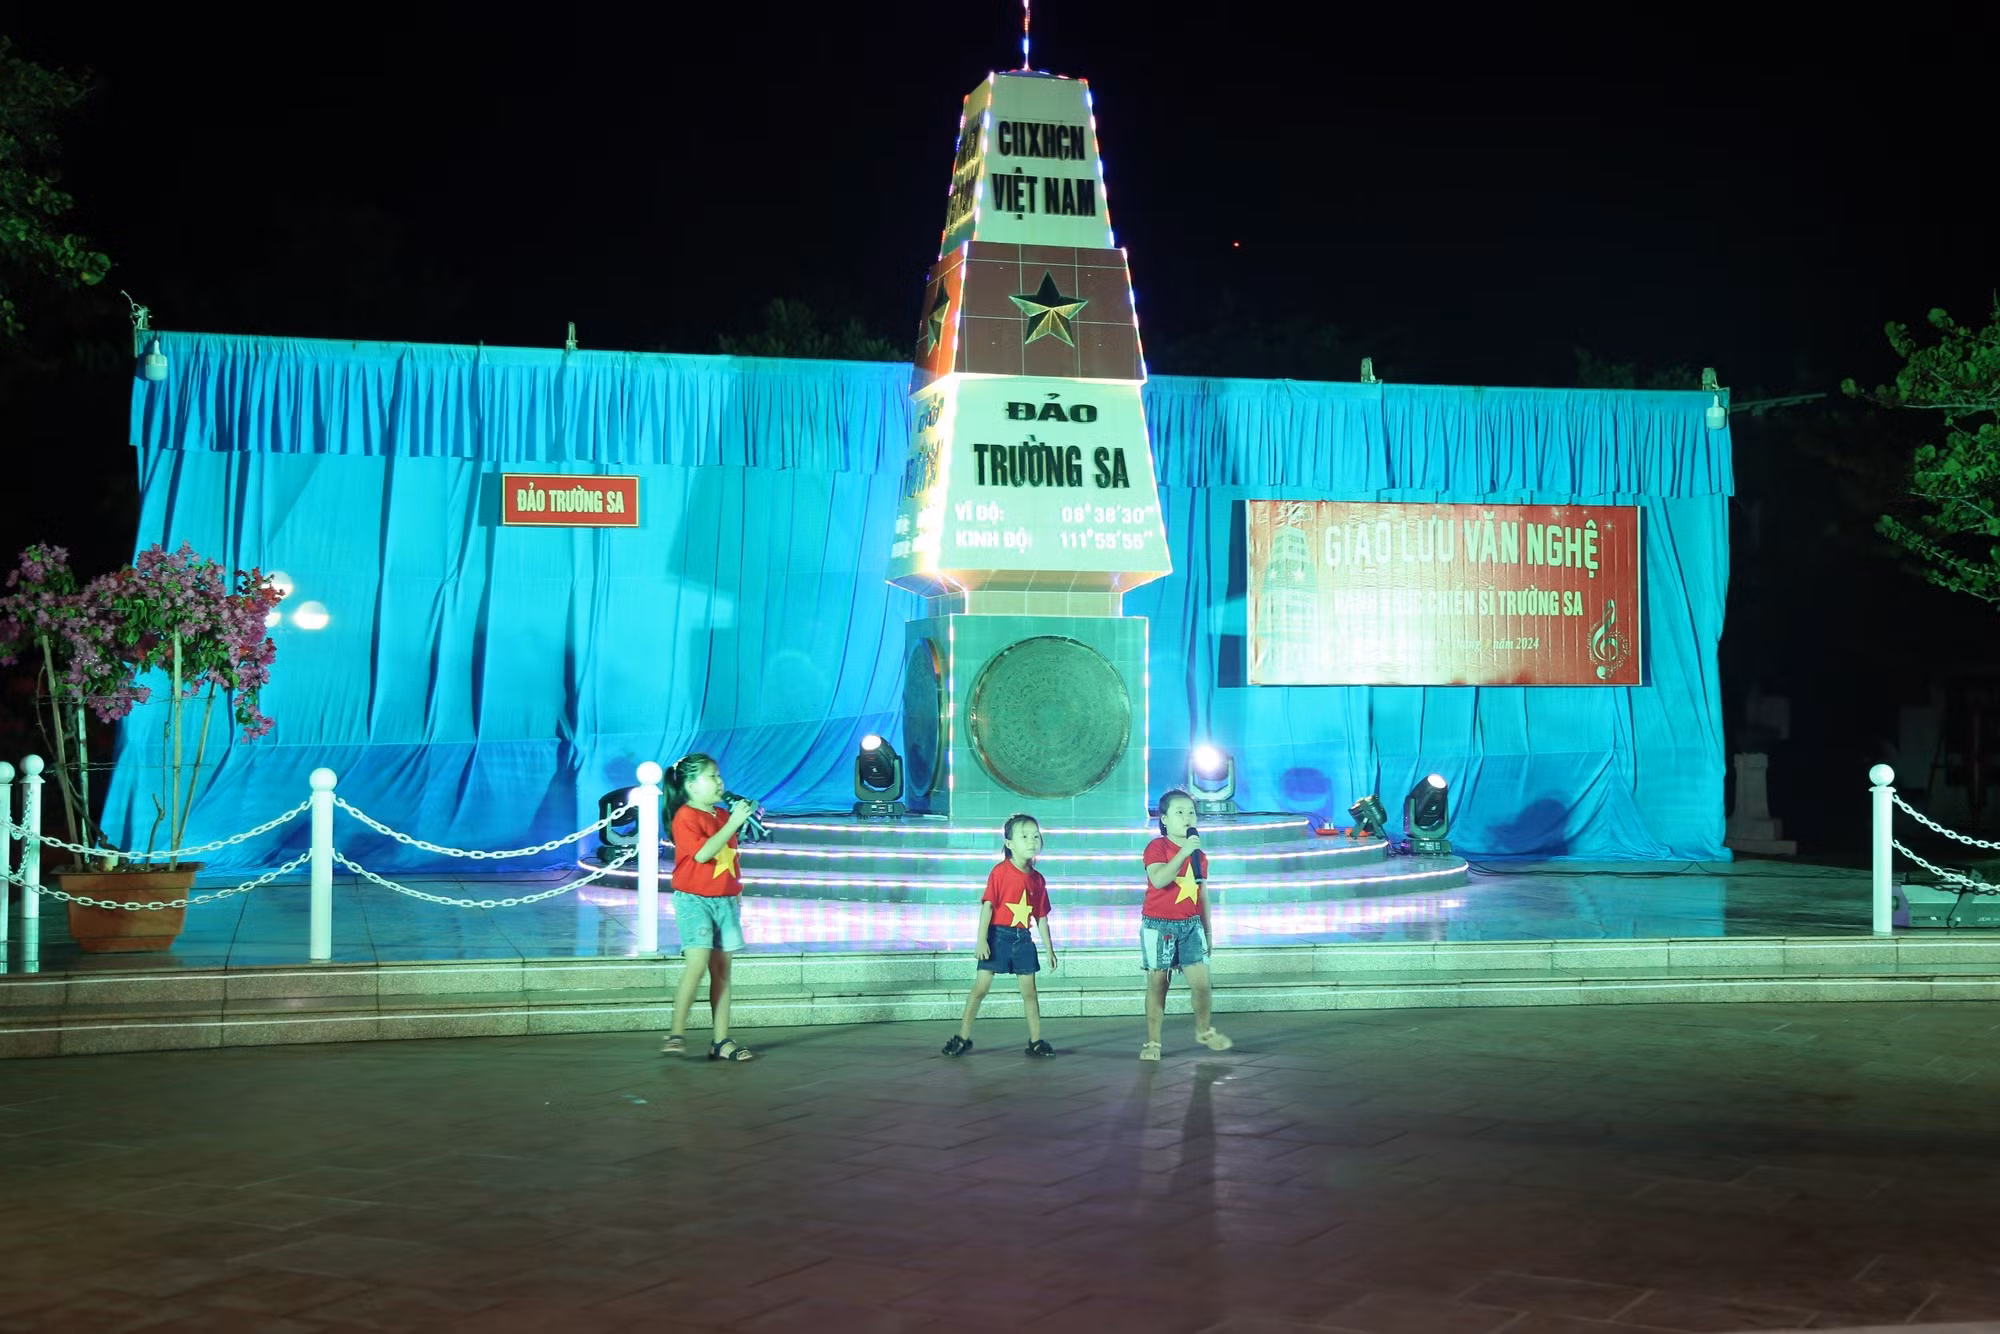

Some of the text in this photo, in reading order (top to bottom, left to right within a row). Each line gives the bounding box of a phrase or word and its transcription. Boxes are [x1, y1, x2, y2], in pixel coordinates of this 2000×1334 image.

[998, 120, 1086, 161] CHXHCN
[991, 166, 1038, 220] VIỆT
[1043, 176, 1096, 217] NAM
[1005, 392, 1098, 423] ĐẢO
[973, 435, 1083, 488] TRƯỜNG
[1093, 446, 1131, 489] SA
[516, 481, 625, 514] ĐẢO TRƯỜNG SA
[1323, 510, 1599, 579] GIAO LƯU VĂN NGHỆ
[1478, 585, 1496, 616] SĨ
[1497, 584, 1560, 617] TRƯỜNG
[1563, 590, 1584, 617] SA
[1492, 638, 1514, 650] năm
[1515, 637, 1540, 650] 2024
